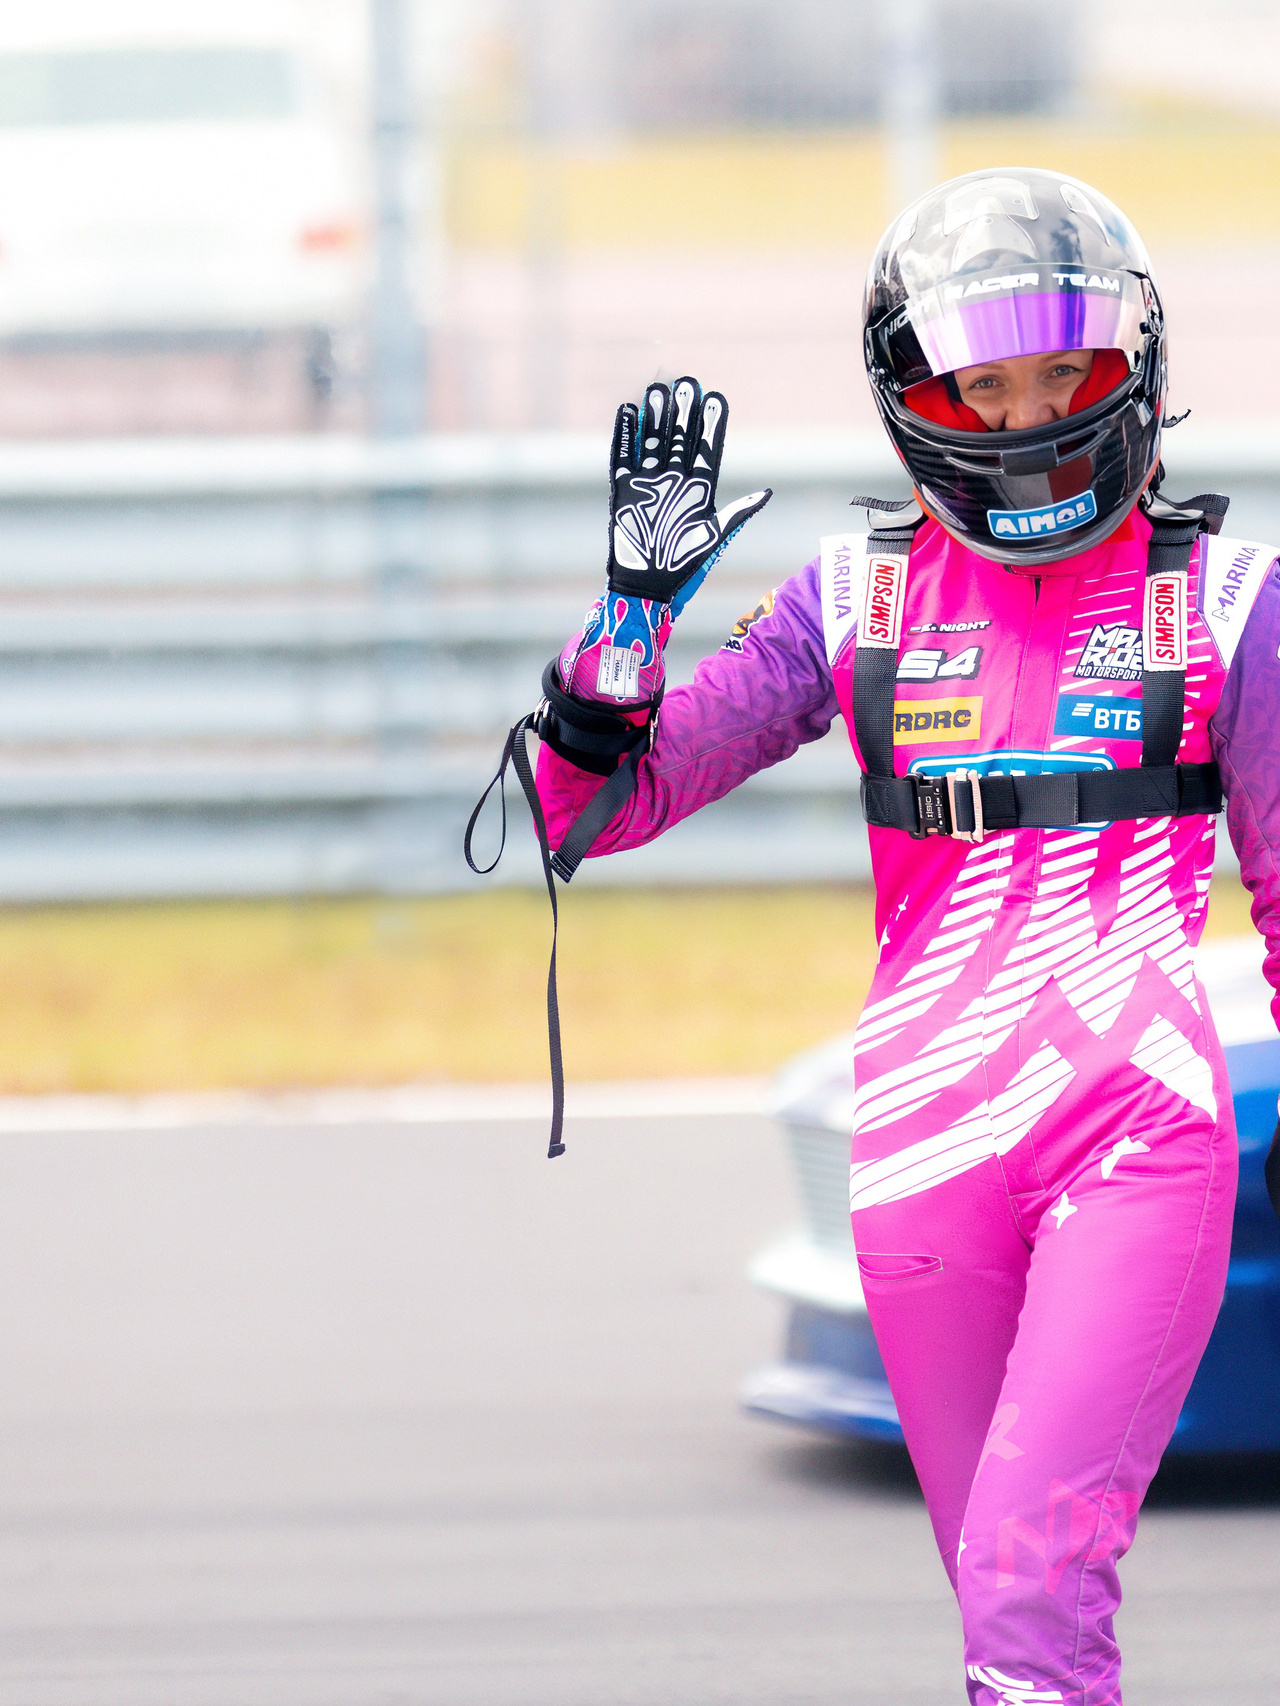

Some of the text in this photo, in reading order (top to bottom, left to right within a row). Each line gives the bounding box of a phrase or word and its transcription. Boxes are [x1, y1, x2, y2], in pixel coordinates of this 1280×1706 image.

[1052, 272, 1120, 292] TEAM
[619, 416, 630, 458] MARINA
[995, 501, 1092, 535] AIMOL
[869, 563, 896, 639] SIMPSON
[1211, 546, 1260, 622] MARINA
[1155, 582, 1176, 661] SIMPSON
[894, 709, 972, 732] RDRC
[1093, 708, 1141, 732] ВТБ
